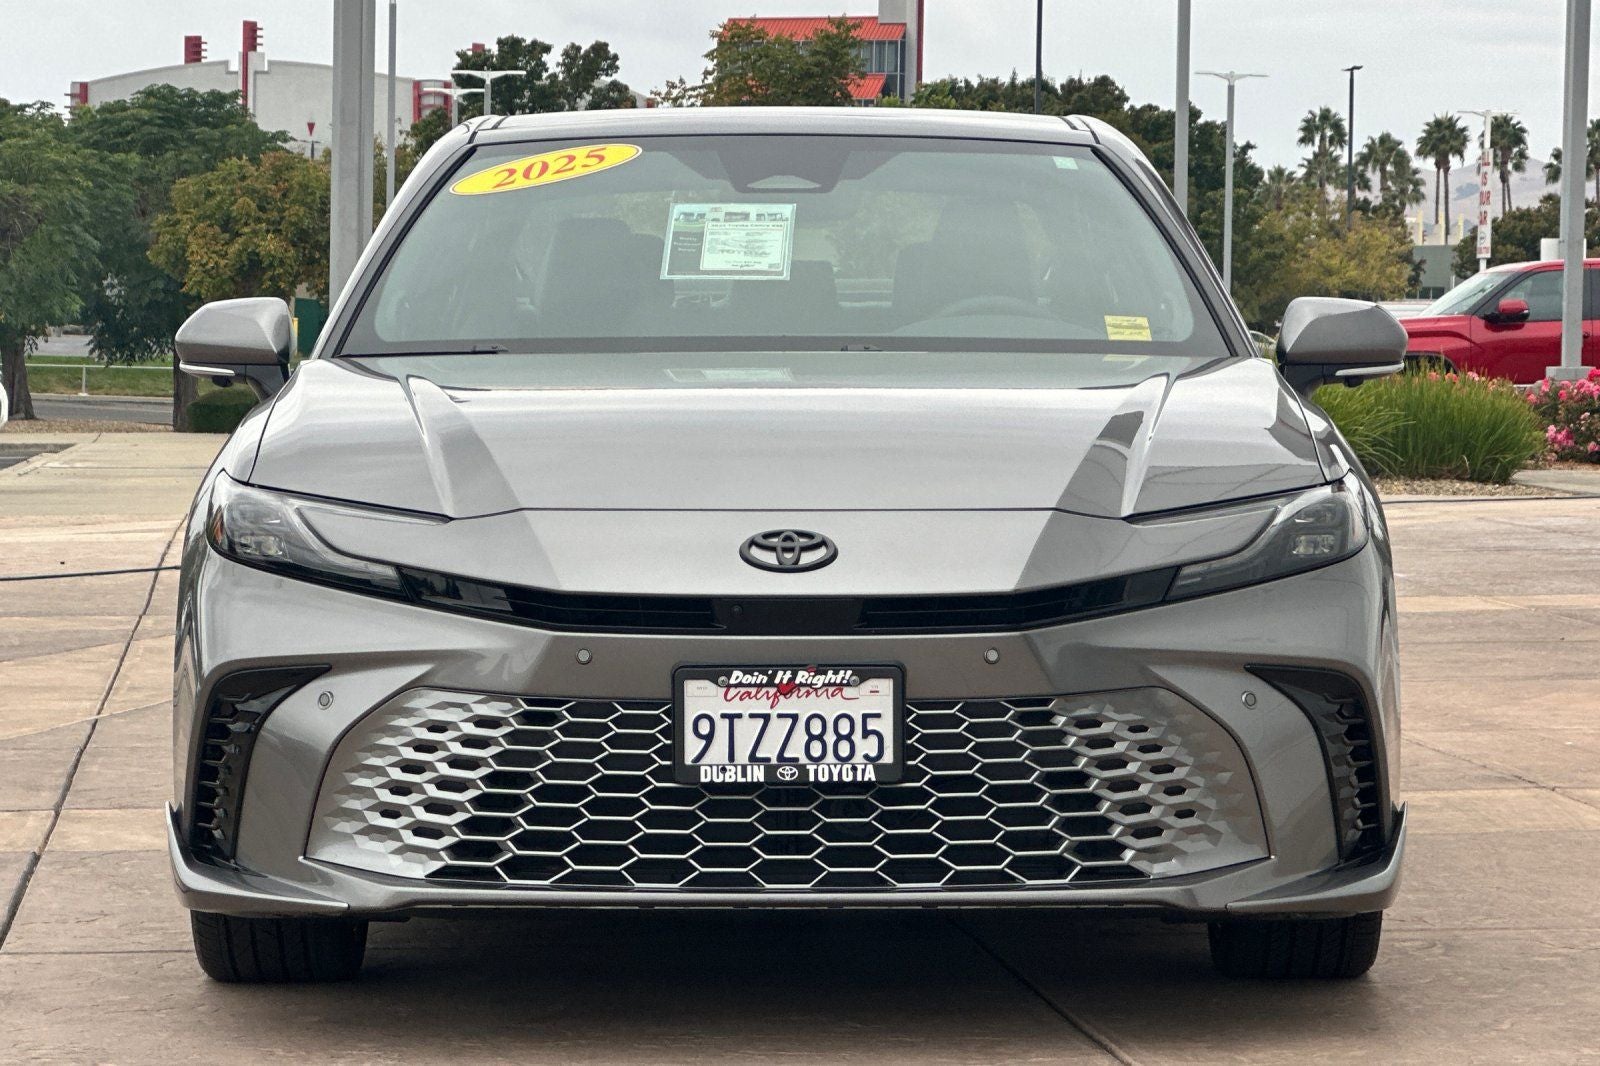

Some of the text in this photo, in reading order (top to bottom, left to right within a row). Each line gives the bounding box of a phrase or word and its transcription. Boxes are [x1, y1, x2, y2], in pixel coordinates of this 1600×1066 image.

[491, 147, 608, 189] 2025
[729, 670, 853, 688] Doin' It Right!
[690, 712, 885, 764] 9TZZ885
[700, 764, 876, 783] DUBLIN TOYOTA
